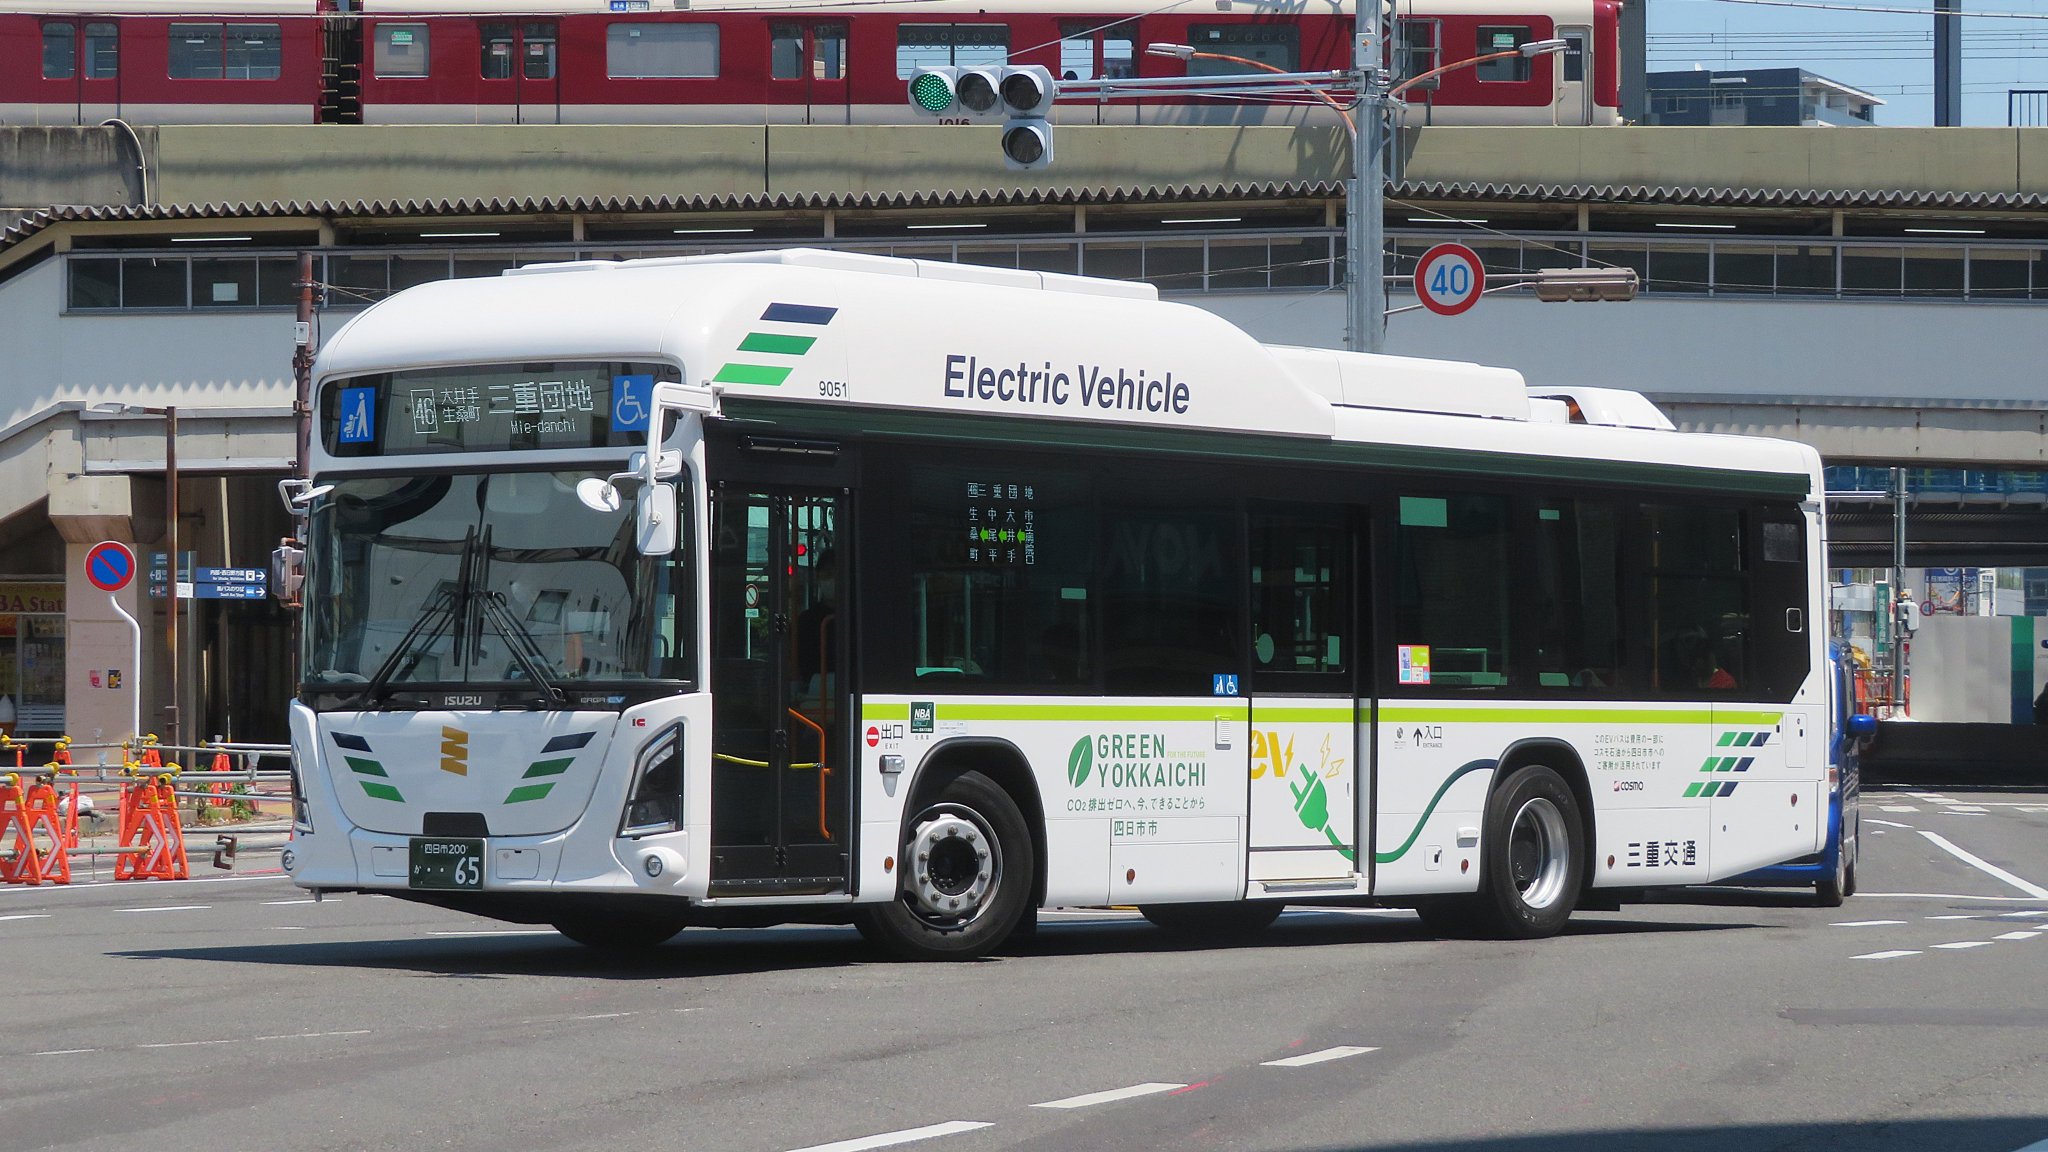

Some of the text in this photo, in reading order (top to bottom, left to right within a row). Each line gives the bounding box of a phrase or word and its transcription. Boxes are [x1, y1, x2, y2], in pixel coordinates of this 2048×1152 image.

[1431, 264, 1468, 295] 40
[819, 380, 847, 398] 9051
[944, 354, 1190, 415] Electric Vehicle
[440, 386, 480, 405] 大井手
[488, 379, 594, 414] 三重団地
[415, 397, 435, 425] 46
[442, 405, 481, 424] 生桑町
[510, 419, 576, 434] Mie-danchi
[444, 696, 482, 705] ISUZU
[914, 708, 931, 718] NBA
[881, 723, 904, 739] 出口
[1424, 725, 1442, 739] 入口
[1098, 733, 1165, 759] GREEN
[1098, 762, 1205, 788] YOKKAICHI
[1620, 781, 1644, 791] COSMO
[1114, 820, 1158, 836] 四日市市
[1627, 840, 1696, 867] 三重交通
